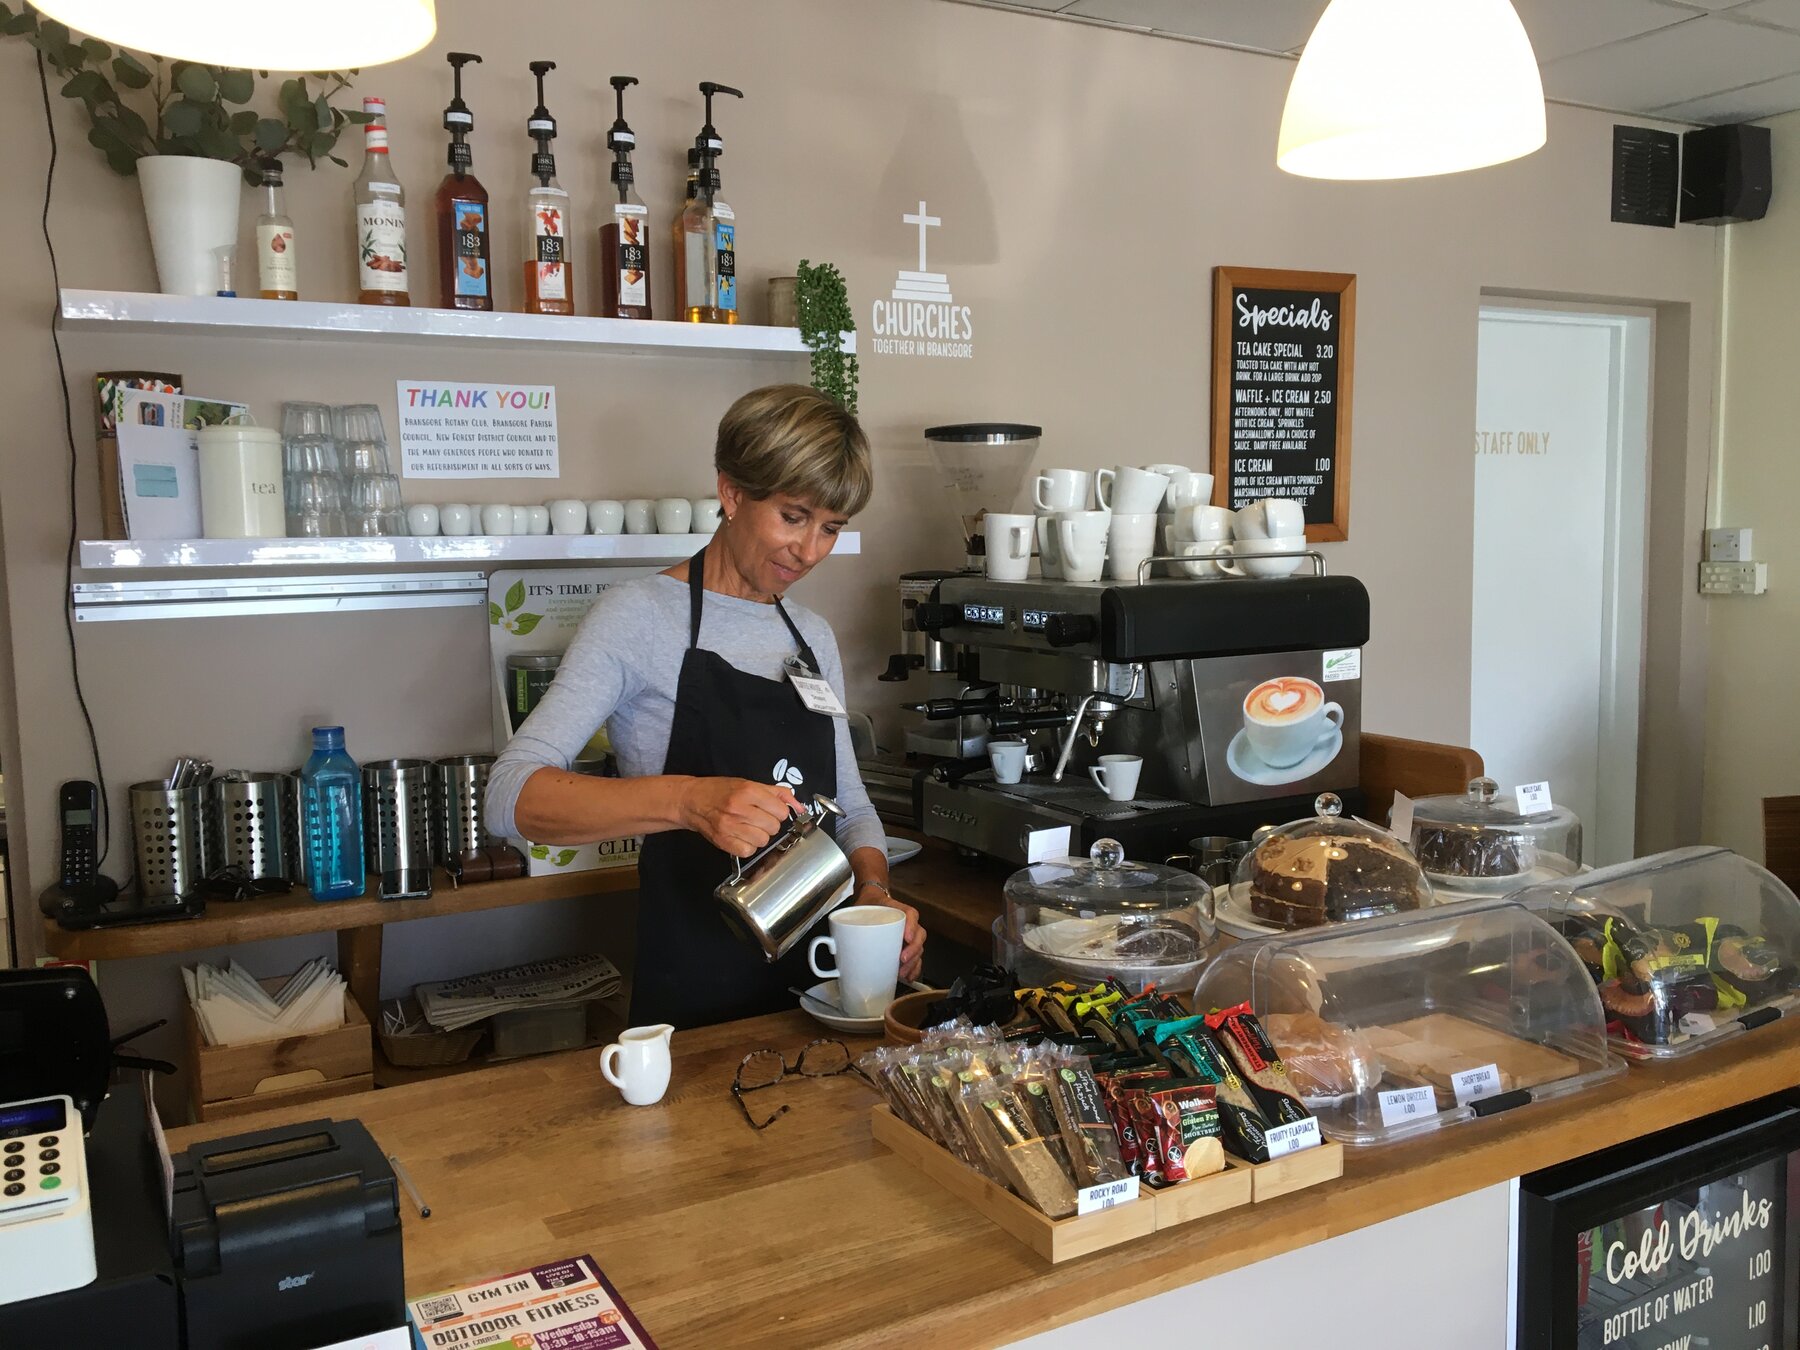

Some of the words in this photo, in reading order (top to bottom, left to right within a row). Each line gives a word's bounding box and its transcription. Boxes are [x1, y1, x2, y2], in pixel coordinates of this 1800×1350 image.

[363, 217, 404, 228] MONIN
[872, 299, 972, 340] CHURCHES
[1236, 293, 1333, 335] Specials
[872, 338, 914, 355] TOGETHER
[916, 341, 924, 356] IN
[927, 341, 973, 358] BRANSGORE
[1237, 342, 1251, 356] TEA
[1253, 342, 1272, 356] CAKE
[1274, 343, 1303, 358] SPECIAL
[1316, 345, 1333, 358] 3.20
[1237, 360, 1258, 370] TOASTED
[1260, 360, 1269, 370] TEA
[1270, 361, 1282, 370] CAKE
[1284, 361, 1297, 371] WITH
[1298, 362, 1308, 371] ANY
[1309, 362, 1319, 371] HOT
[1253, 372, 1262, 381] FOR
[1264, 373, 1267, 381] A
[1268, 372, 1284, 382] LARGE
[1285, 373, 1299, 382] DRINK
[1301, 373, 1311, 382] ADD
[1312, 373, 1322, 383] 20P
[407, 389, 488, 408] THANK
[496, 391, 550, 409] YOU!
[1236, 389, 1263, 403] WAFFLE
[1272, 390, 1283, 403] ICE
[1286, 390, 1310, 403] CREAM
[1314, 391, 1332, 404] 2.50
[1235, 407, 1267, 416] AFTERNOONS
[1284, 408, 1295, 416] HOT
[1296, 408, 1314, 417] WAFFLE
[405, 417, 442, 426] BRANSGORE
[445, 418, 468, 427] ROTARY
[492, 418, 528, 427] BRANSGORE
[530, 418, 553, 427] PARISH
[1235, 419, 1248, 428] WITH
[1278, 419, 1304, 428] SPRINKLES
[436, 433, 450, 441] NEW
[452, 433, 475, 442] FOREST
[478, 433, 504, 442] DISTRICT
[506, 434, 532, 442] COUNCIL
[1234, 430, 1274, 439] MARSHMALLOWS
[1276, 430, 1286, 438] AND
[1287, 430, 1290, 438] A
[1291, 430, 1308, 438] CHOICE
[1309, 430, 1316, 438] OF
[1254, 441, 1268, 450] DAIRY
[1269, 441, 1280, 450] FREE
[1282, 441, 1307, 450] AVAILABLE
[1473, 431, 1513, 454] STAFF
[1517, 431, 1550, 454] ONLY
[411, 463, 424, 471] OUR
[427, 463, 479, 471] REFURBISHMENT
[504, 463, 523, 471] SORTS
[535, 463, 552, 471] WAYS.
[1235, 459, 1246, 472] ICE
[1248, 459, 1272, 472] CREAM
[1316, 458, 1330, 471] 1.00
[1234, 476, 1249, 486] BOWL
[1250, 476, 1256, 485] OF
[1266, 476, 1282, 485] CREAM
[1283, 476, 1296, 485] WITH
[1297, 475, 1322, 484] SPRINKLES
[251, 482, 276, 494] tea
[1234, 487, 1274, 497] MARSHMALLOWS
[1276, 487, 1286, 496] AND
[1287, 487, 1290, 496] A
[1291, 486, 1308, 495] CHOICE
[1309, 486, 1316, 495] OF
[528, 585, 553, 596] IT'S
[557, 584, 592, 595] TIME
[1461, 1071, 1490, 1086] SHORTBREAD
[1387, 1094, 1406, 1105] LEMON
[1406, 1090, 1428, 1102] DRIZZLE
[1404, 1104, 1416, 1114] 1.00
[1183, 1116, 1204, 1126] Gluten
[1270, 1130, 1288, 1144] FRUITY
[1289, 1121, 1315, 1137] FLAPJACK
[1288, 1139, 1300, 1150] 1.00
[1090, 1186, 1110, 1201] ROCKY
[1112, 1182, 1128, 1196] ROAD
[1102, 1198, 1115, 1209] 100
[1606, 1220, 1674, 1285] Cold
[1679, 1189, 1772, 1261] Drinks
[536, 1264, 574, 1276] FEATURING
[279, 1273, 312, 1291] star
[468, 1286, 502, 1304] GYM
[1604, 1302, 1651, 1345] BOTTLE
[1655, 1294, 1670, 1322] OF
[1674, 1275, 1714, 1315] WATER
[1750, 1249, 1771, 1280] 1.00
[432, 1314, 521, 1346] OUTDOOR
[525, 1293, 599, 1322] FITNESS
[1748, 1300, 1766, 1330] 1.10
[536, 1321, 598, 1341] Wednesday
[473, 1334, 501, 1346] COURSE
